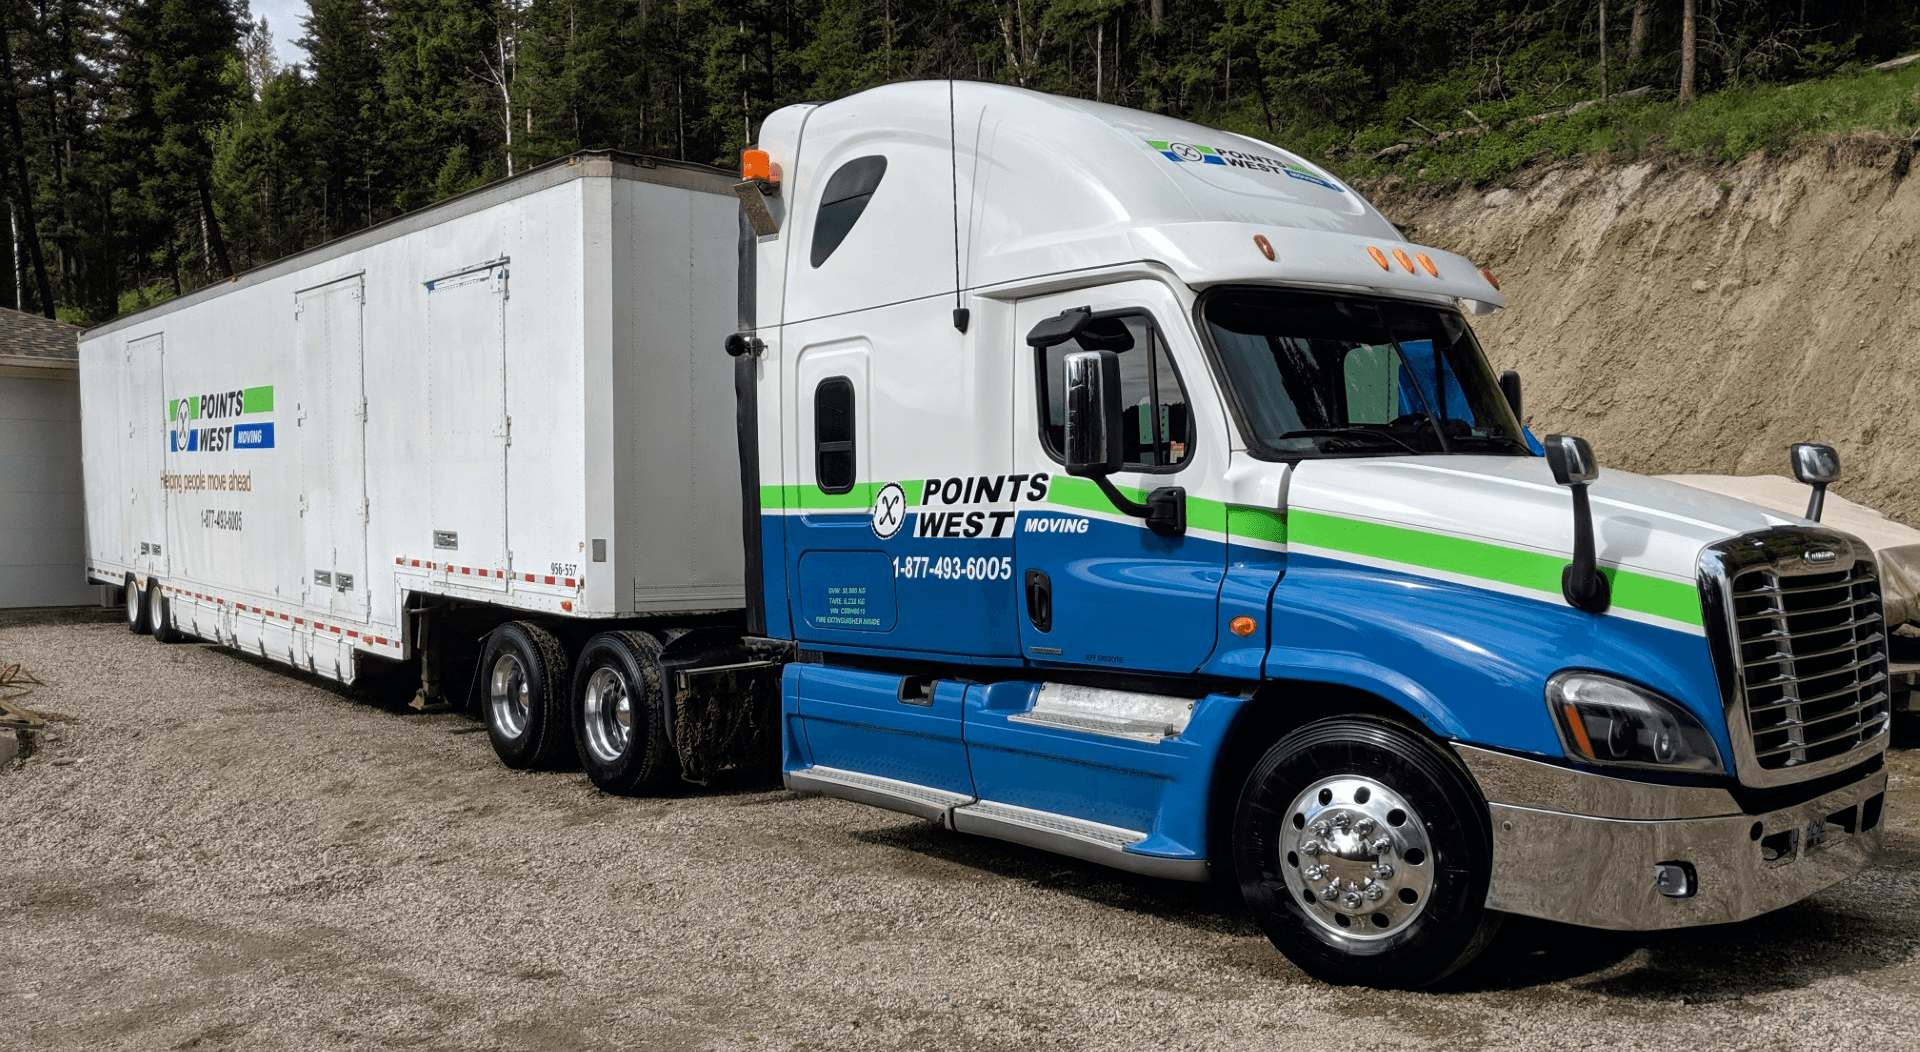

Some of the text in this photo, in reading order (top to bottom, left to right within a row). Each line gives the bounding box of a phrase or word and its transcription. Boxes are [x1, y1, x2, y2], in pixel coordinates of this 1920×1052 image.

[1214, 148, 1287, 168] POINTS
[1224, 157, 1281, 175] WEST
[200, 389, 243, 419] POINTS
[200, 427, 263, 451] WEST MOVING
[160, 469, 252, 495] Helping people move ahead
[921, 472, 1049, 506] POINTS
[201, 508, 243, 532] 1-877-493-6005
[919, 511, 1089, 538] WEST MOVING
[550, 562, 577, 577] 956-557
[892, 556, 1012, 580] 1-877-493-6005
